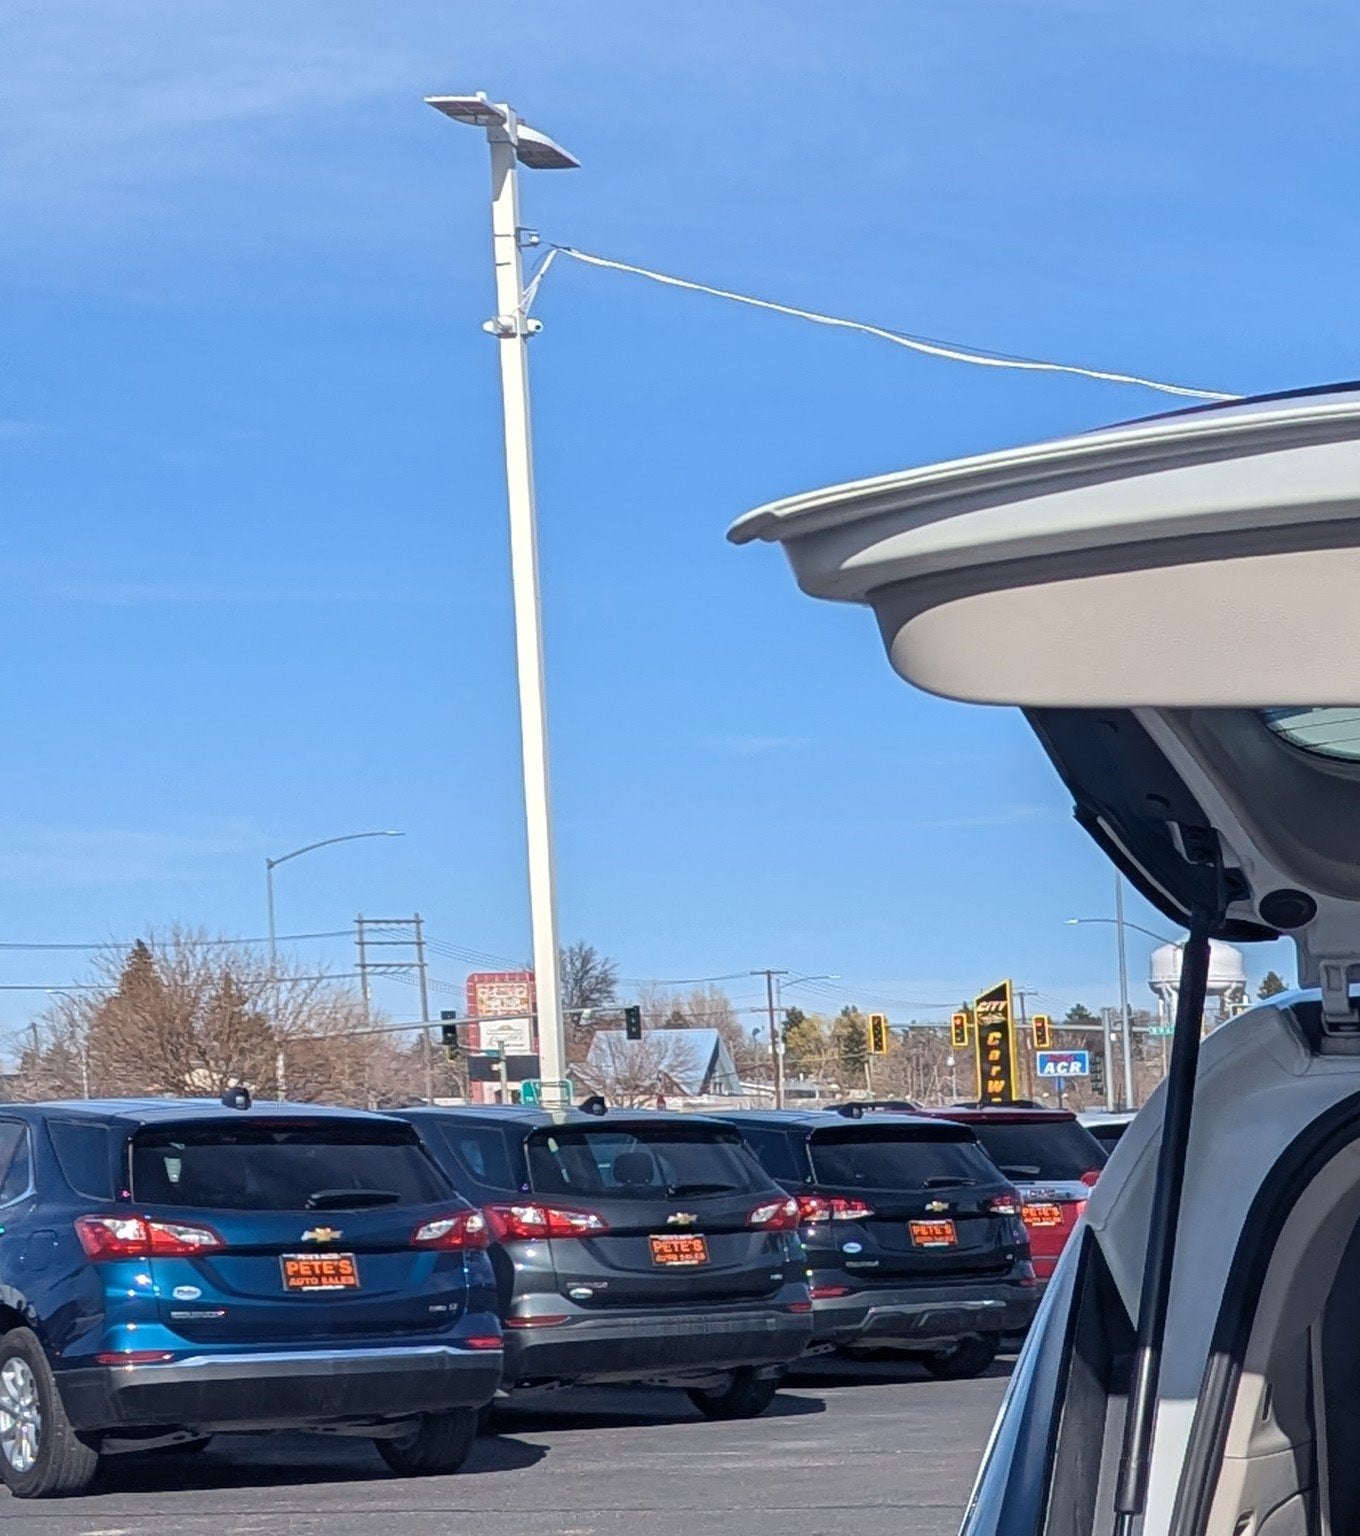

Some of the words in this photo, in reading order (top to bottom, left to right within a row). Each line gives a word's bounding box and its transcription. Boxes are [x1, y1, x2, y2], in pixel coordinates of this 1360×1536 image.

[1044, 1061, 1082, 1074] ACR
[652, 1240, 703, 1252] PETE'S
[285, 1260, 353, 1275] PETE'S
[288, 1277, 319, 1287] AUTO
[321, 1275, 356, 1285] SALES
